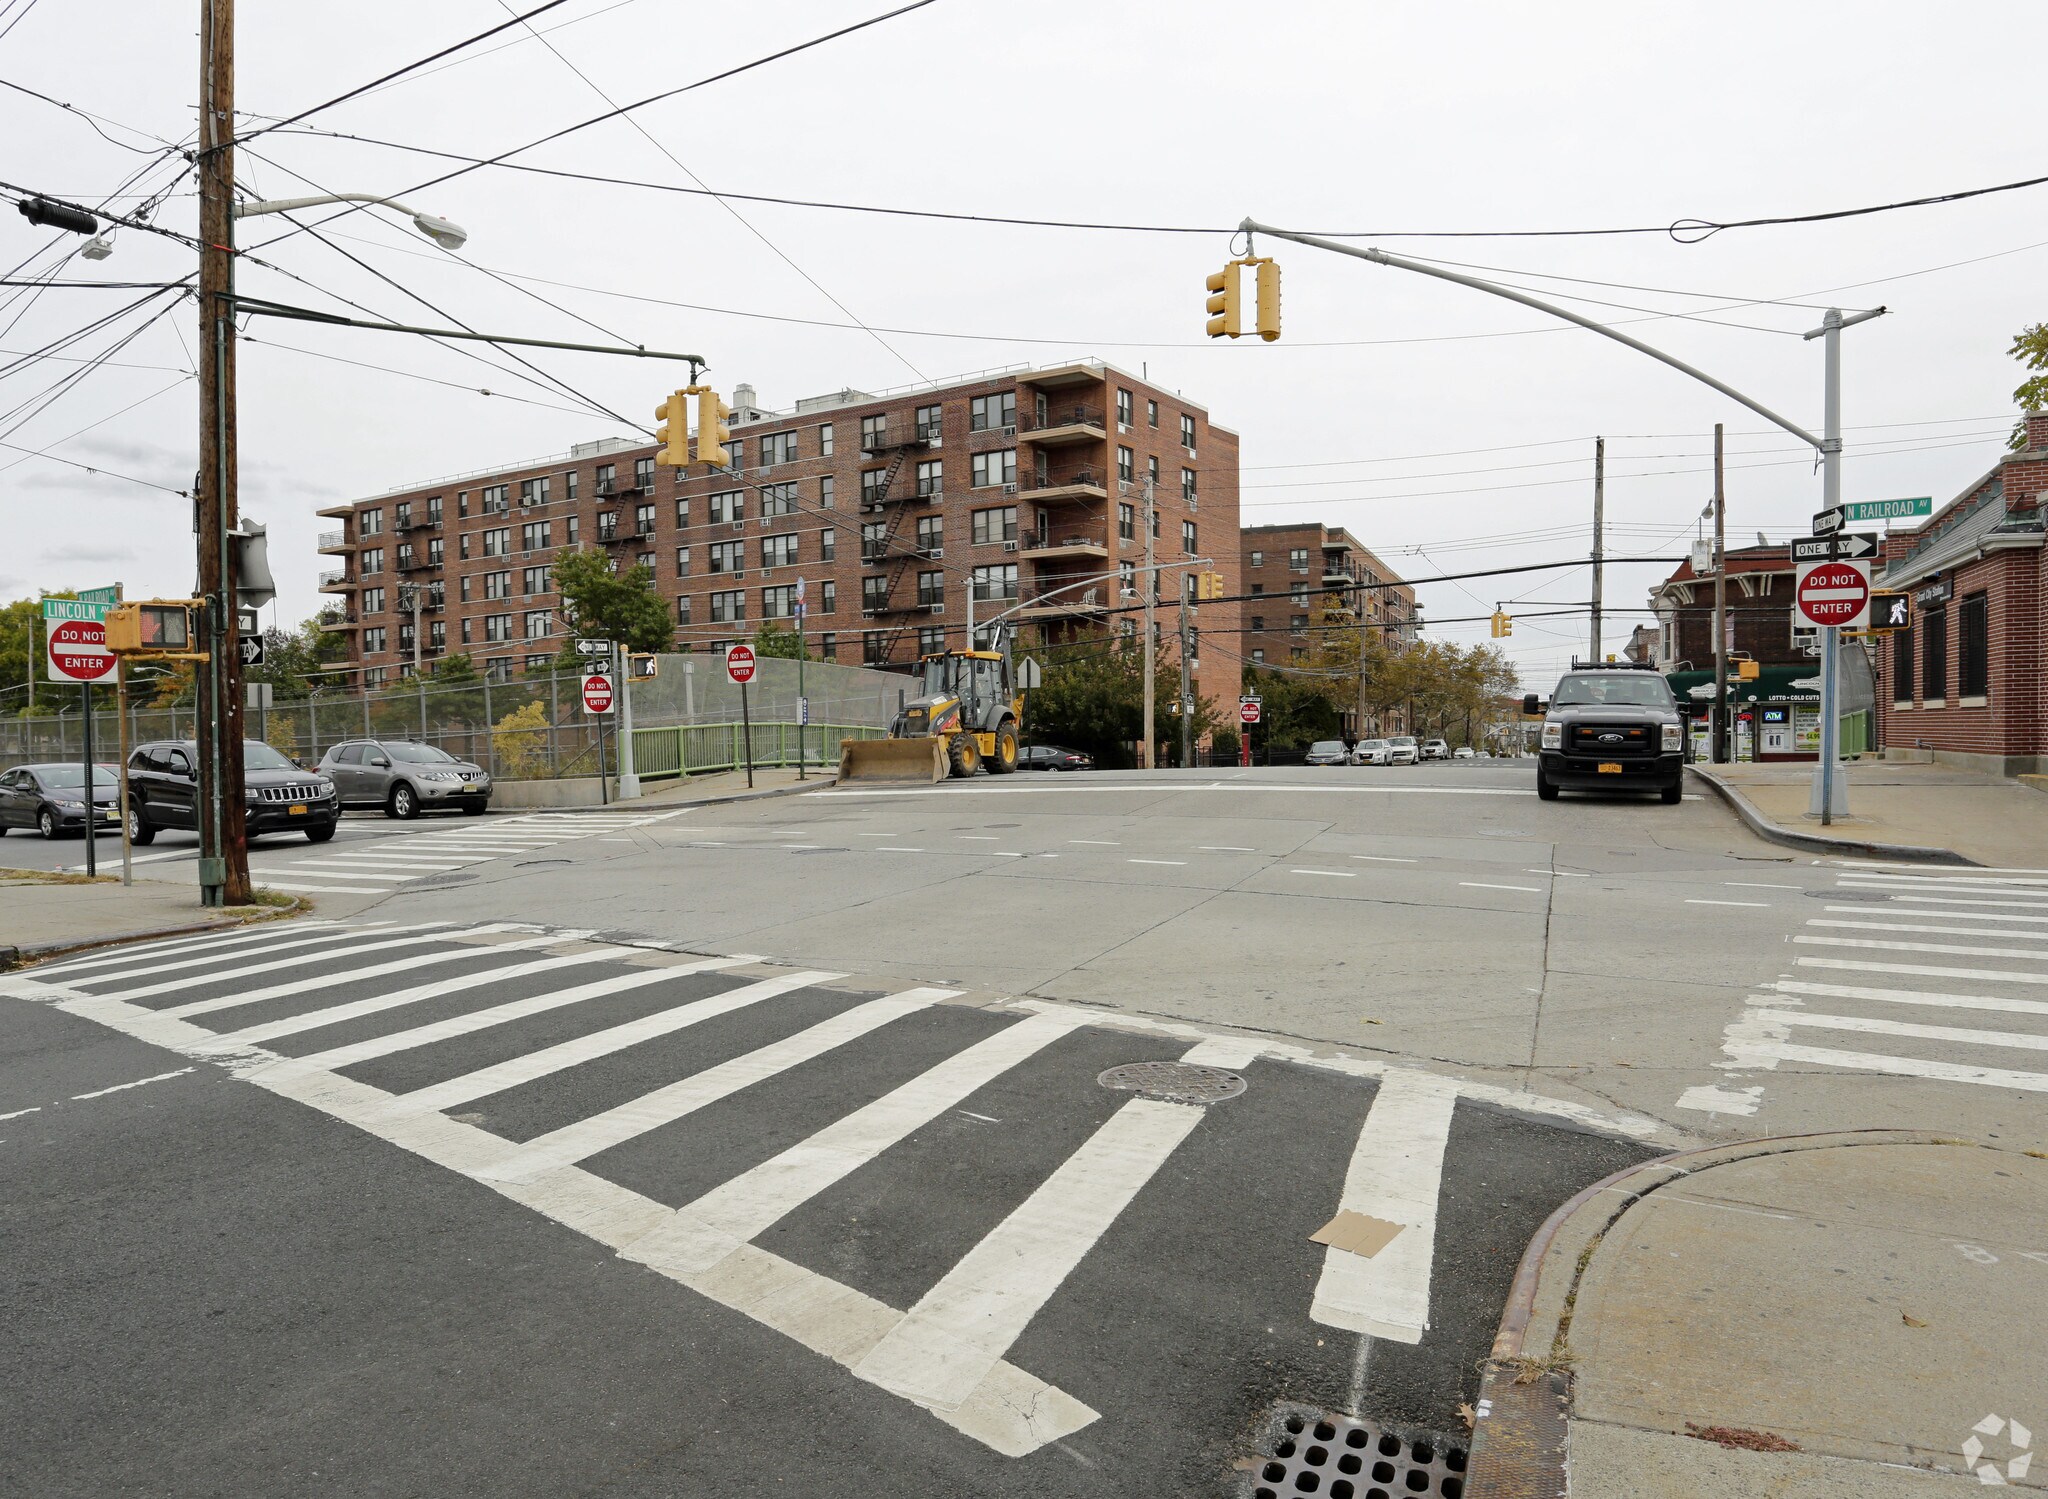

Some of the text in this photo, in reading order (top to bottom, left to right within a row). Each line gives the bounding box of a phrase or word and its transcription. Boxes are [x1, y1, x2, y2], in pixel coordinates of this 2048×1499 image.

[1847, 506, 1854, 519] N
[1860, 501, 1914, 518] RAILROAD
[1815, 515, 1835, 530] ONE WAY
[1799, 544, 1821, 555] ONE
[1810, 574, 1856, 586] DO NOT
[48, 601, 96, 619] LINCOLN
[1812, 603, 1852, 614] ENTER
[61, 630, 106, 641] DO NOT
[65, 657, 104, 668] ENTER
[1765, 712, 1782, 720] ATM
